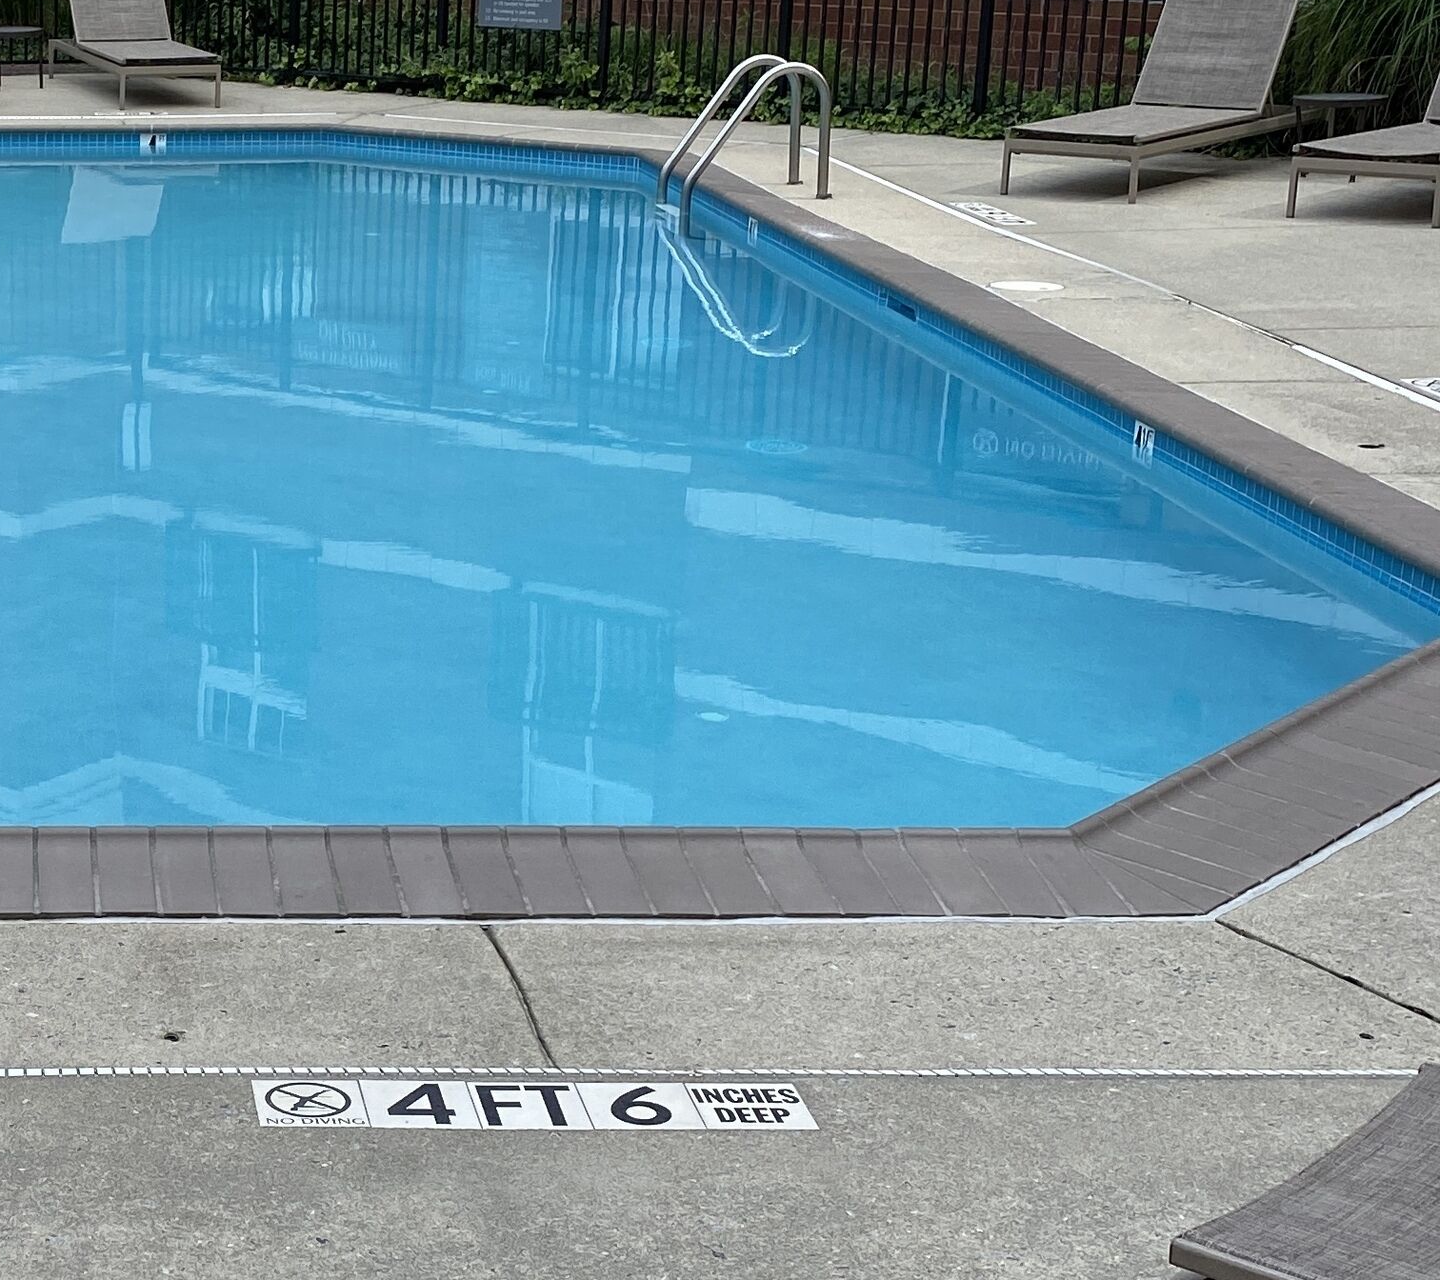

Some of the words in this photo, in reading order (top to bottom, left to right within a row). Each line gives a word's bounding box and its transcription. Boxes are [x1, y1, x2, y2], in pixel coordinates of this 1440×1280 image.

[388, 1084, 456, 1125] 4
[475, 1086, 570, 1126] FT
[610, 1086, 672, 1126] 6
[692, 1088, 800, 1105] INCHES
[266, 1117, 296, 1126] NO
[301, 1116, 366, 1126] DIVING
[716, 1106, 790, 1124] DEEP
